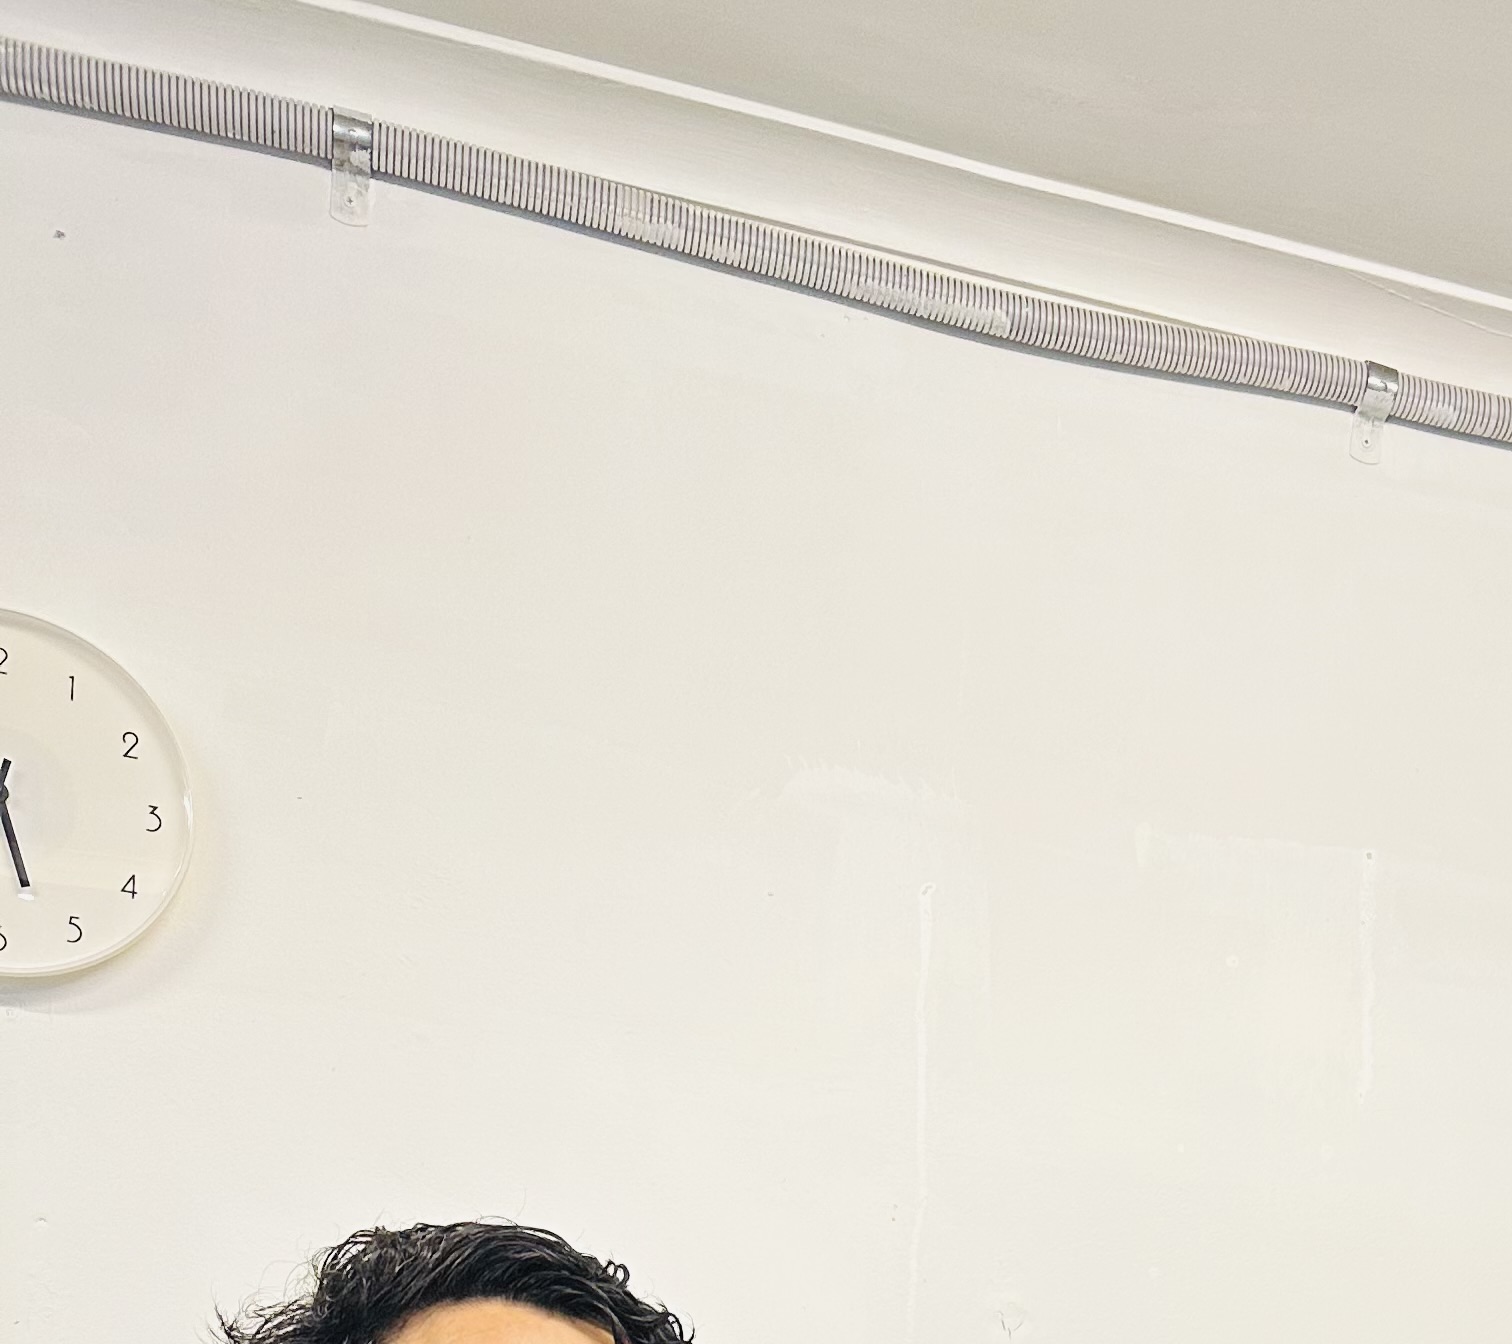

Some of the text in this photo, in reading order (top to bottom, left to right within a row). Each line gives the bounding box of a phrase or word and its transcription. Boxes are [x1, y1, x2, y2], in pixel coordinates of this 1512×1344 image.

[68, 675, 75, 701] 1
[122, 731, 139, 760] 2
[146, 804, 162, 832] 3
[120, 874, 138, 900] 4
[66, 915, 83, 943] 5
